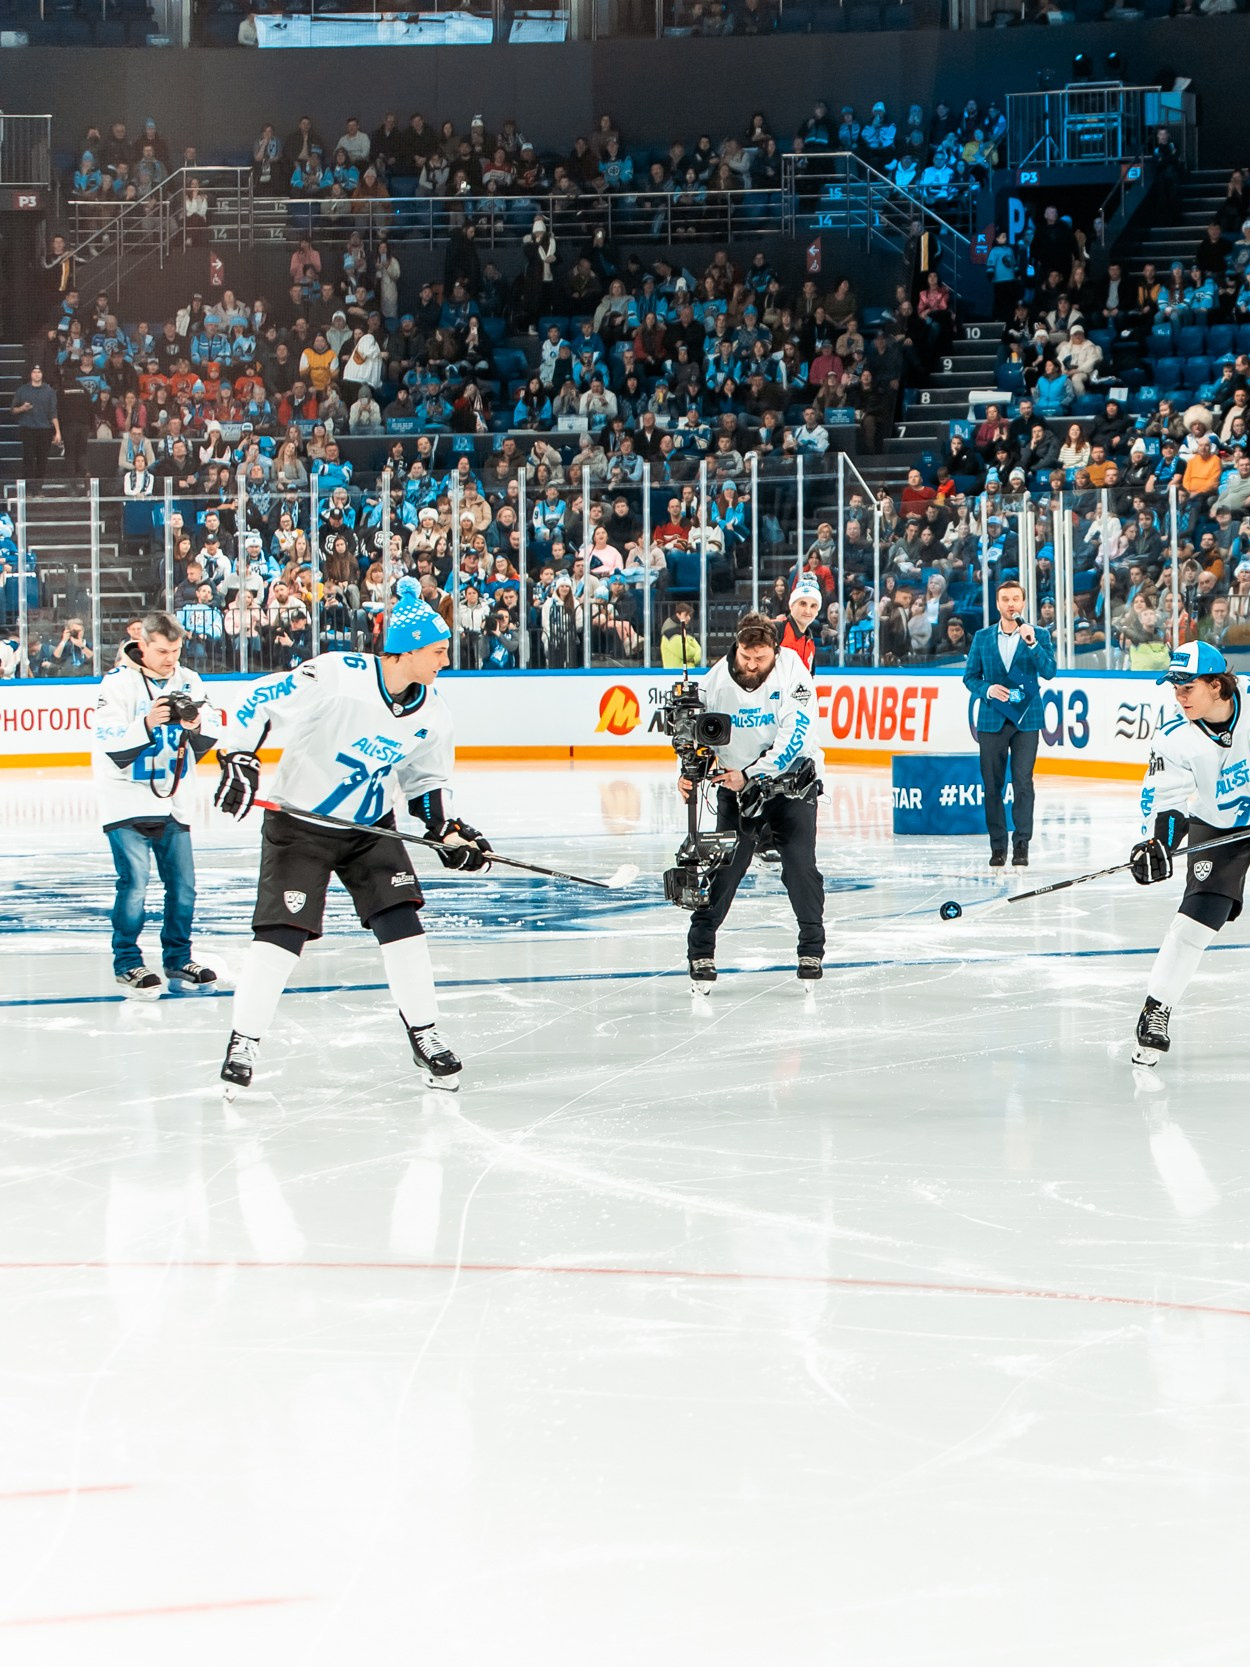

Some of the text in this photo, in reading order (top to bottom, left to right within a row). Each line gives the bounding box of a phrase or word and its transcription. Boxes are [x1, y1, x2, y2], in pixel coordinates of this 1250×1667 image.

[1021, 172, 1038, 184] P3
[19, 195, 37, 208] P3
[1009, 197, 1025, 246] P
[966, 327, 981, 339] 10
[943, 358, 953, 371] 9
[921, 392, 931, 404] 8
[898, 426, 907, 438] 7
[0, 707, 95, 732] НОГОЛО
[815, 684, 939, 742] FONBET
[311, 752, 392, 826] 76
